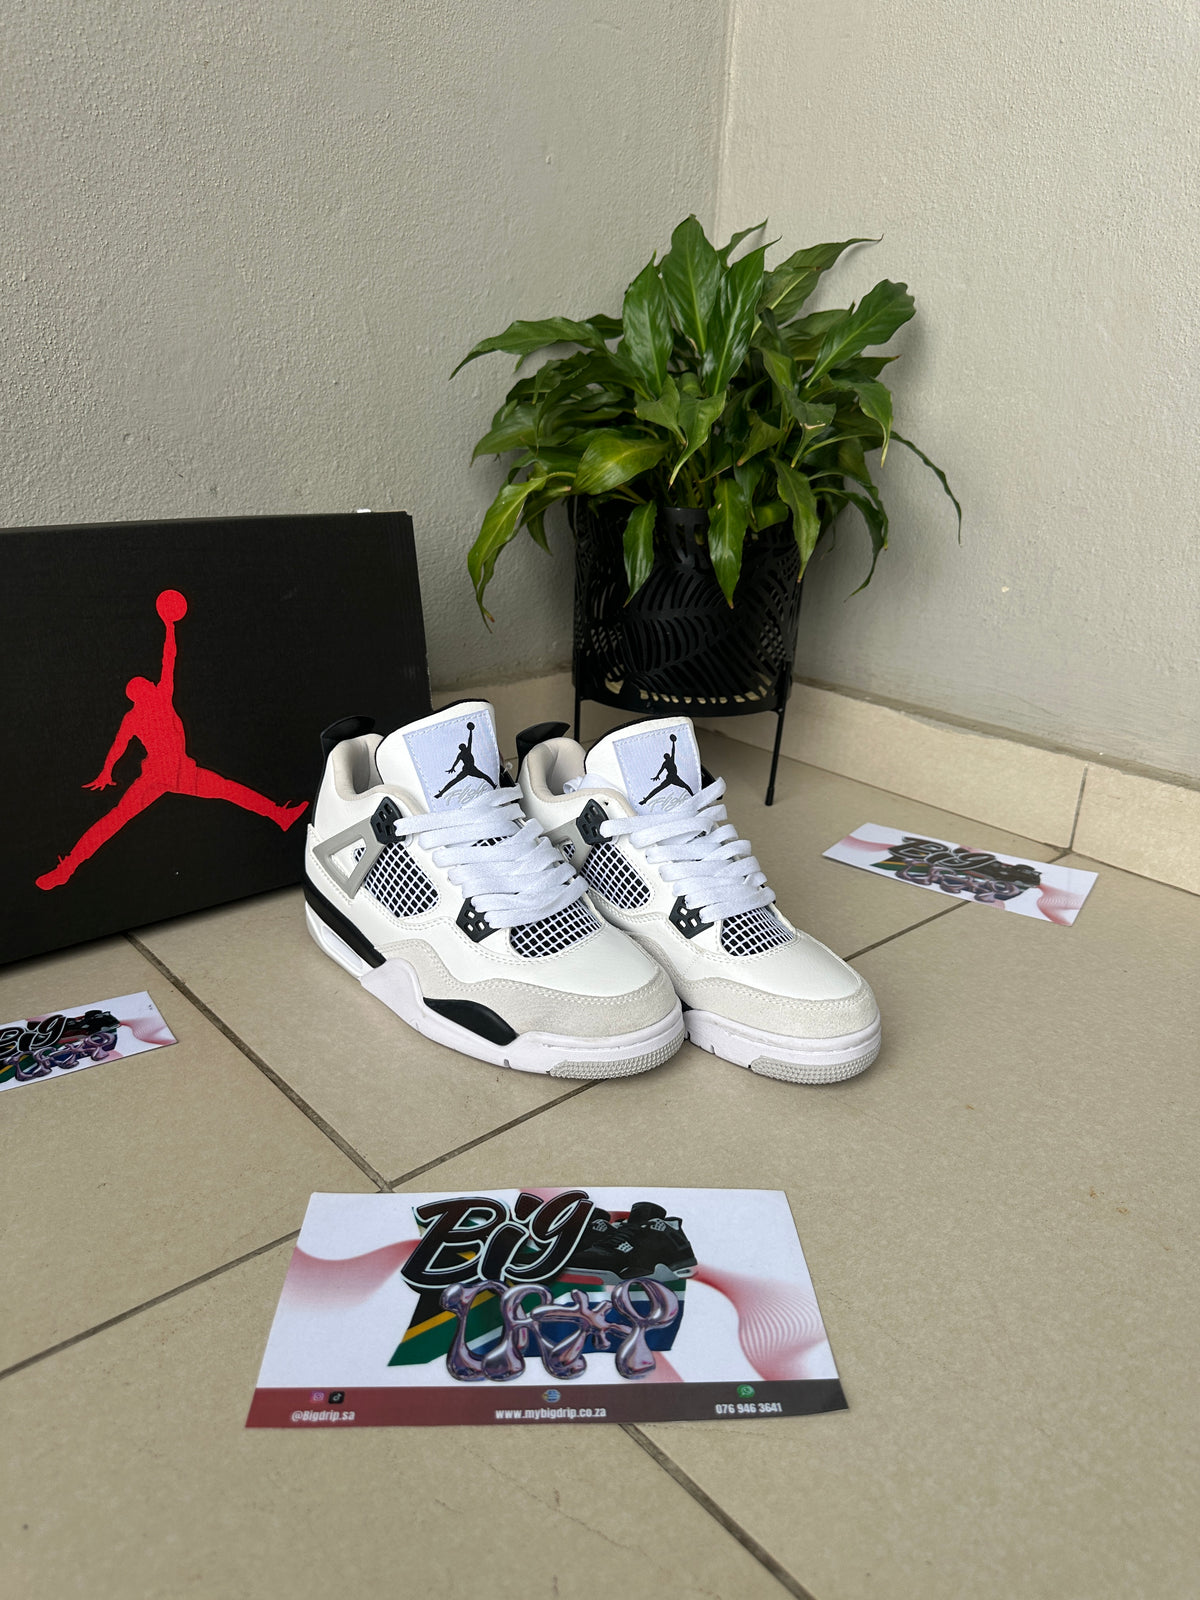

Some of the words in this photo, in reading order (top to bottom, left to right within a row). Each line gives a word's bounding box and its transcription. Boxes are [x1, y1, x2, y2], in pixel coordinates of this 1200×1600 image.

[401, 1190, 597, 1289] Big
[495, 1407, 607, 1420] www.mybigdrip.co.za
[715, 1404, 736, 1414] 076
[736, 1403, 757, 1413] 946
[758, 1402, 783, 1413] 3641
[291, 1409, 356, 1423] @Bigdrip.sa
